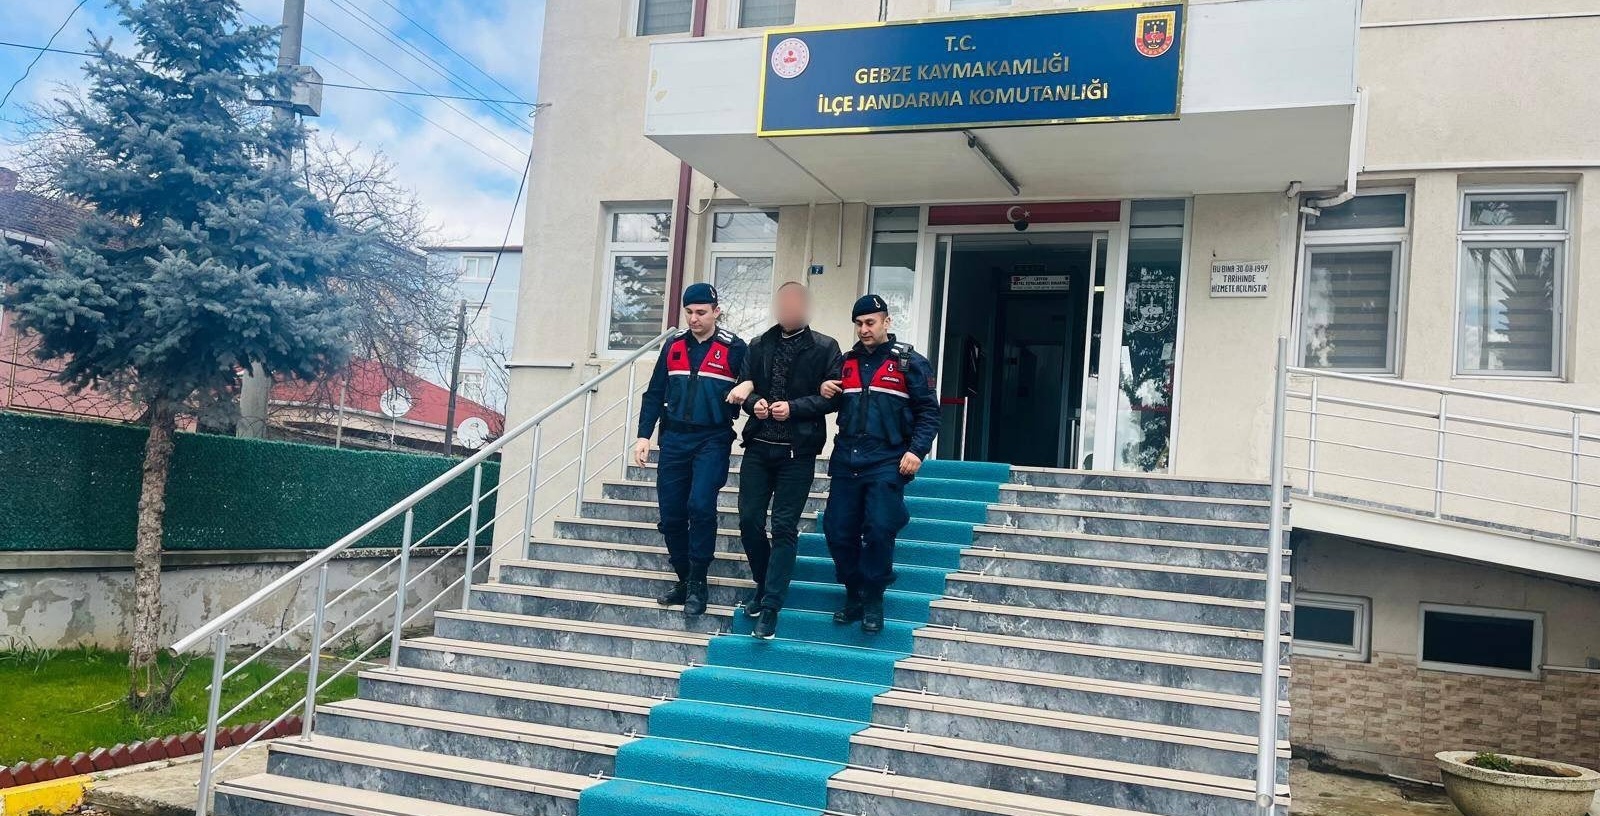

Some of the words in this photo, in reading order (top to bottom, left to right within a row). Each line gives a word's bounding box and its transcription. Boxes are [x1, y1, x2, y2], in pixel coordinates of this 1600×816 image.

[945, 35, 977, 52] T.C.
[855, 65, 912, 84] GEBZE
[918, 52, 1069, 81] KAYMAKAMLIĞI
[818, 94, 854, 116] İLÇE
[857, 90, 964, 112] JANDARMA
[969, 78, 1109, 105] KOMUTANLIĞI
